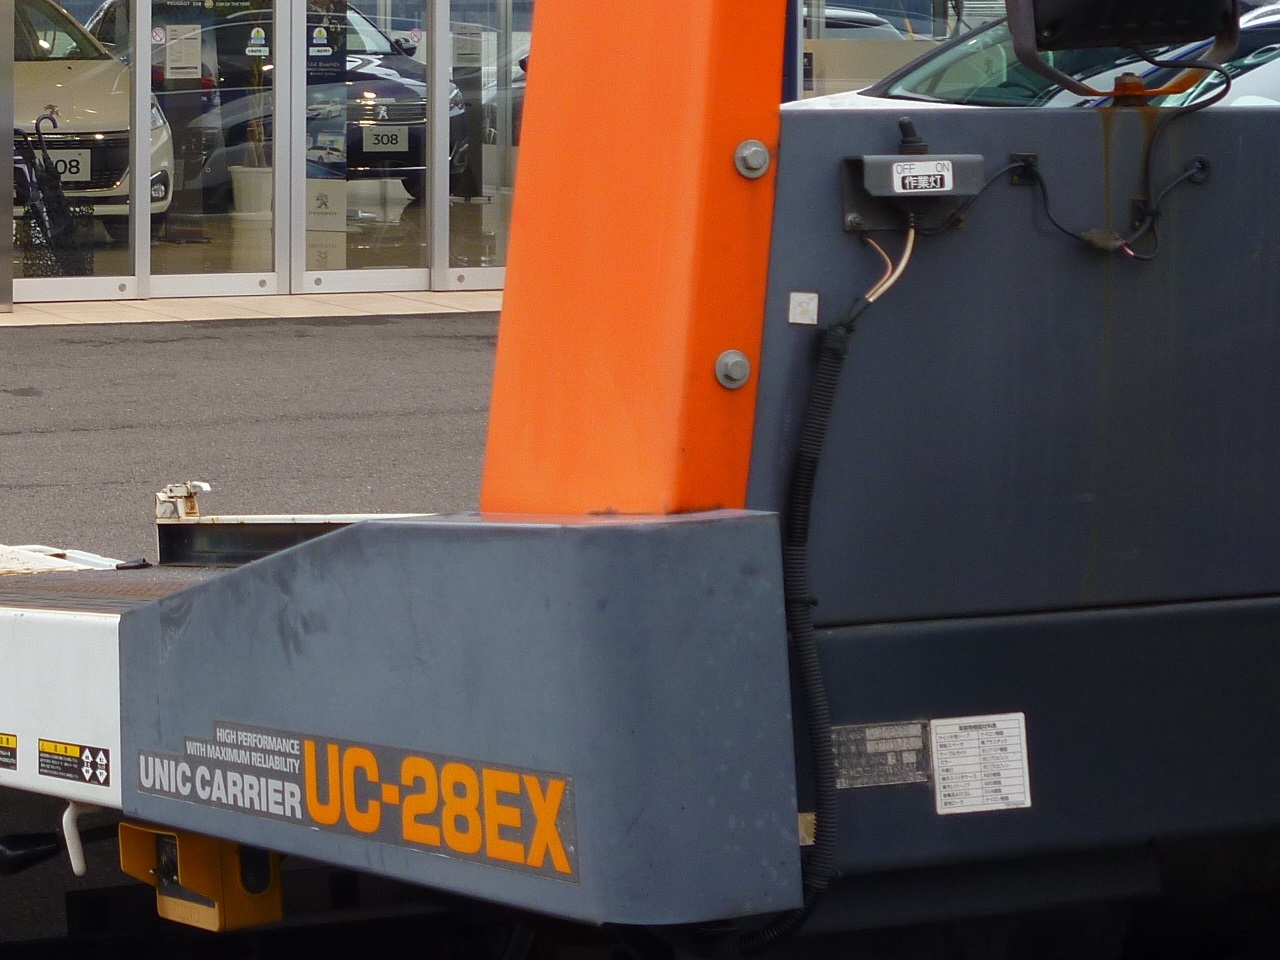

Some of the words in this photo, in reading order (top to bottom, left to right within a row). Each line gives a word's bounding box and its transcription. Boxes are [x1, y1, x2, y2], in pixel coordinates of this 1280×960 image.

[372, 133, 399, 146] 308
[55, 158, 81, 175] 08
[895, 163, 916, 175] OFF
[935, 162, 950, 173] ON
[904, 174, 942, 190] 作業灯
[216, 727, 237, 743] HIGH
[237, 731, 301, 755] PERFORMANCE
[186, 740, 207, 756] WITH
[206, 744, 251, 765] MAXIMUM
[250, 751, 300, 775] RELIABILITY
[139, 754, 193, 797] UNIC
[195, 765, 303, 820] CARRIER
[303, 740, 573, 875] UC-28EX
